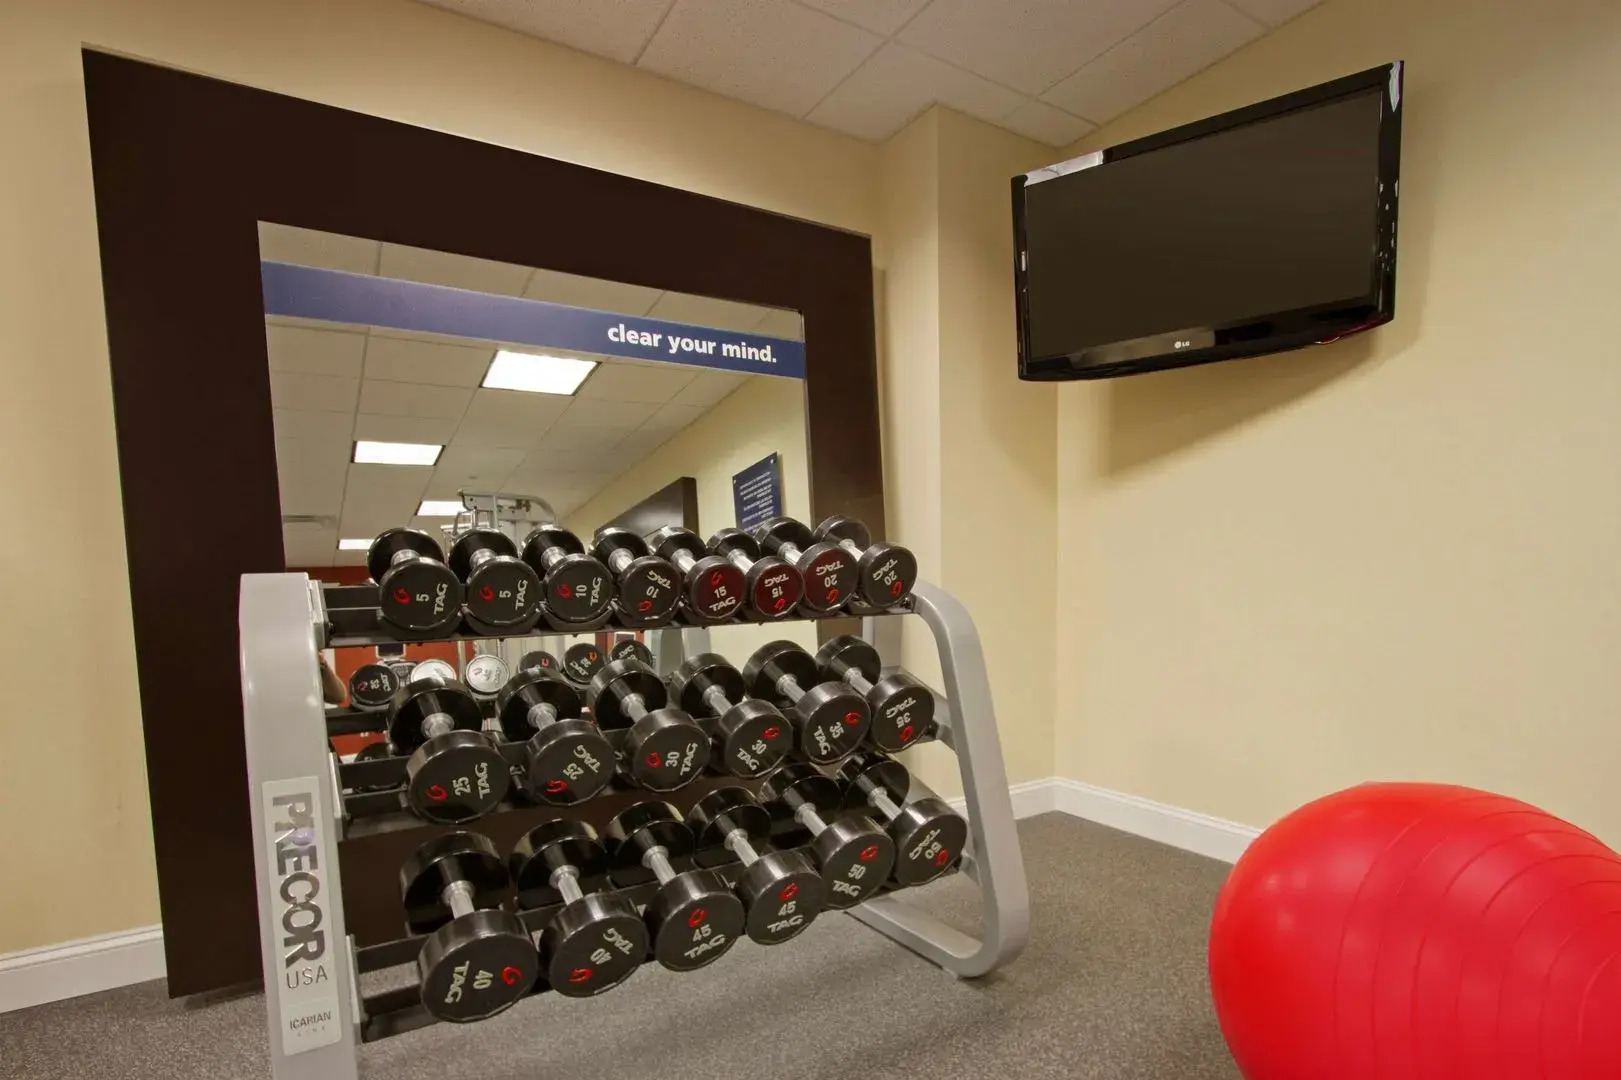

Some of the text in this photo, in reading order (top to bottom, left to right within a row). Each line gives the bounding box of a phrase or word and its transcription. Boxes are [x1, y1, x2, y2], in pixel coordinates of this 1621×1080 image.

[607, 323, 777, 363] clear your mind.
[815, 560, 844, 576] TAG
[872, 558, 898, 581] TAG
[646, 570, 671, 589] TAG
[764, 572, 790, 588] TAG
[824, 574, 838, 588] 20
[884, 571, 898, 587] 20
[416, 593, 430, 602] 5
[433, 582, 449, 615] TAG
[499, 589, 512, 599] 5
[515, 579, 529, 611] TAG
[575, 584, 588, 598] 10
[590, 577, 603, 607] TAG
[646, 585, 660, 599] 10
[714, 585, 728, 599] 15
[771, 586, 783, 599] 15
[708, 596, 736, 612] TAG
[886, 696, 917, 719] TAG
[896, 711, 911, 728] 35
[829, 721, 846, 740] 35
[751, 739, 767, 755] 30
[812, 726, 831, 756] TAG
[572, 744, 602, 774] TAG
[665, 751, 681, 768] 30
[679, 741, 699, 777] TAG
[735, 747, 760, 772] TAG
[474, 761, 491, 799] TAG
[562, 762, 585, 781] 25
[452, 776, 472, 797] 25
[909, 828, 942, 861] TAG
[924, 842, 942, 860] 50
[272, 792, 326, 969] PRECOR
[847, 864, 866, 880] 50
[831, 879, 862, 898] TAG
[778, 901, 797, 917] 45
[692, 923, 712, 943] 45
[766, 915, 804, 934] TAG
[602, 927, 635, 956] TAG
[684, 933, 726, 960] TAG
[589, 947, 613, 966] 40
[286, 965, 328, 989] USA
[444, 960, 471, 1005] TAG
[472, 969, 494, 990] 40
[290, 1010, 331, 1030] ICARIAN
